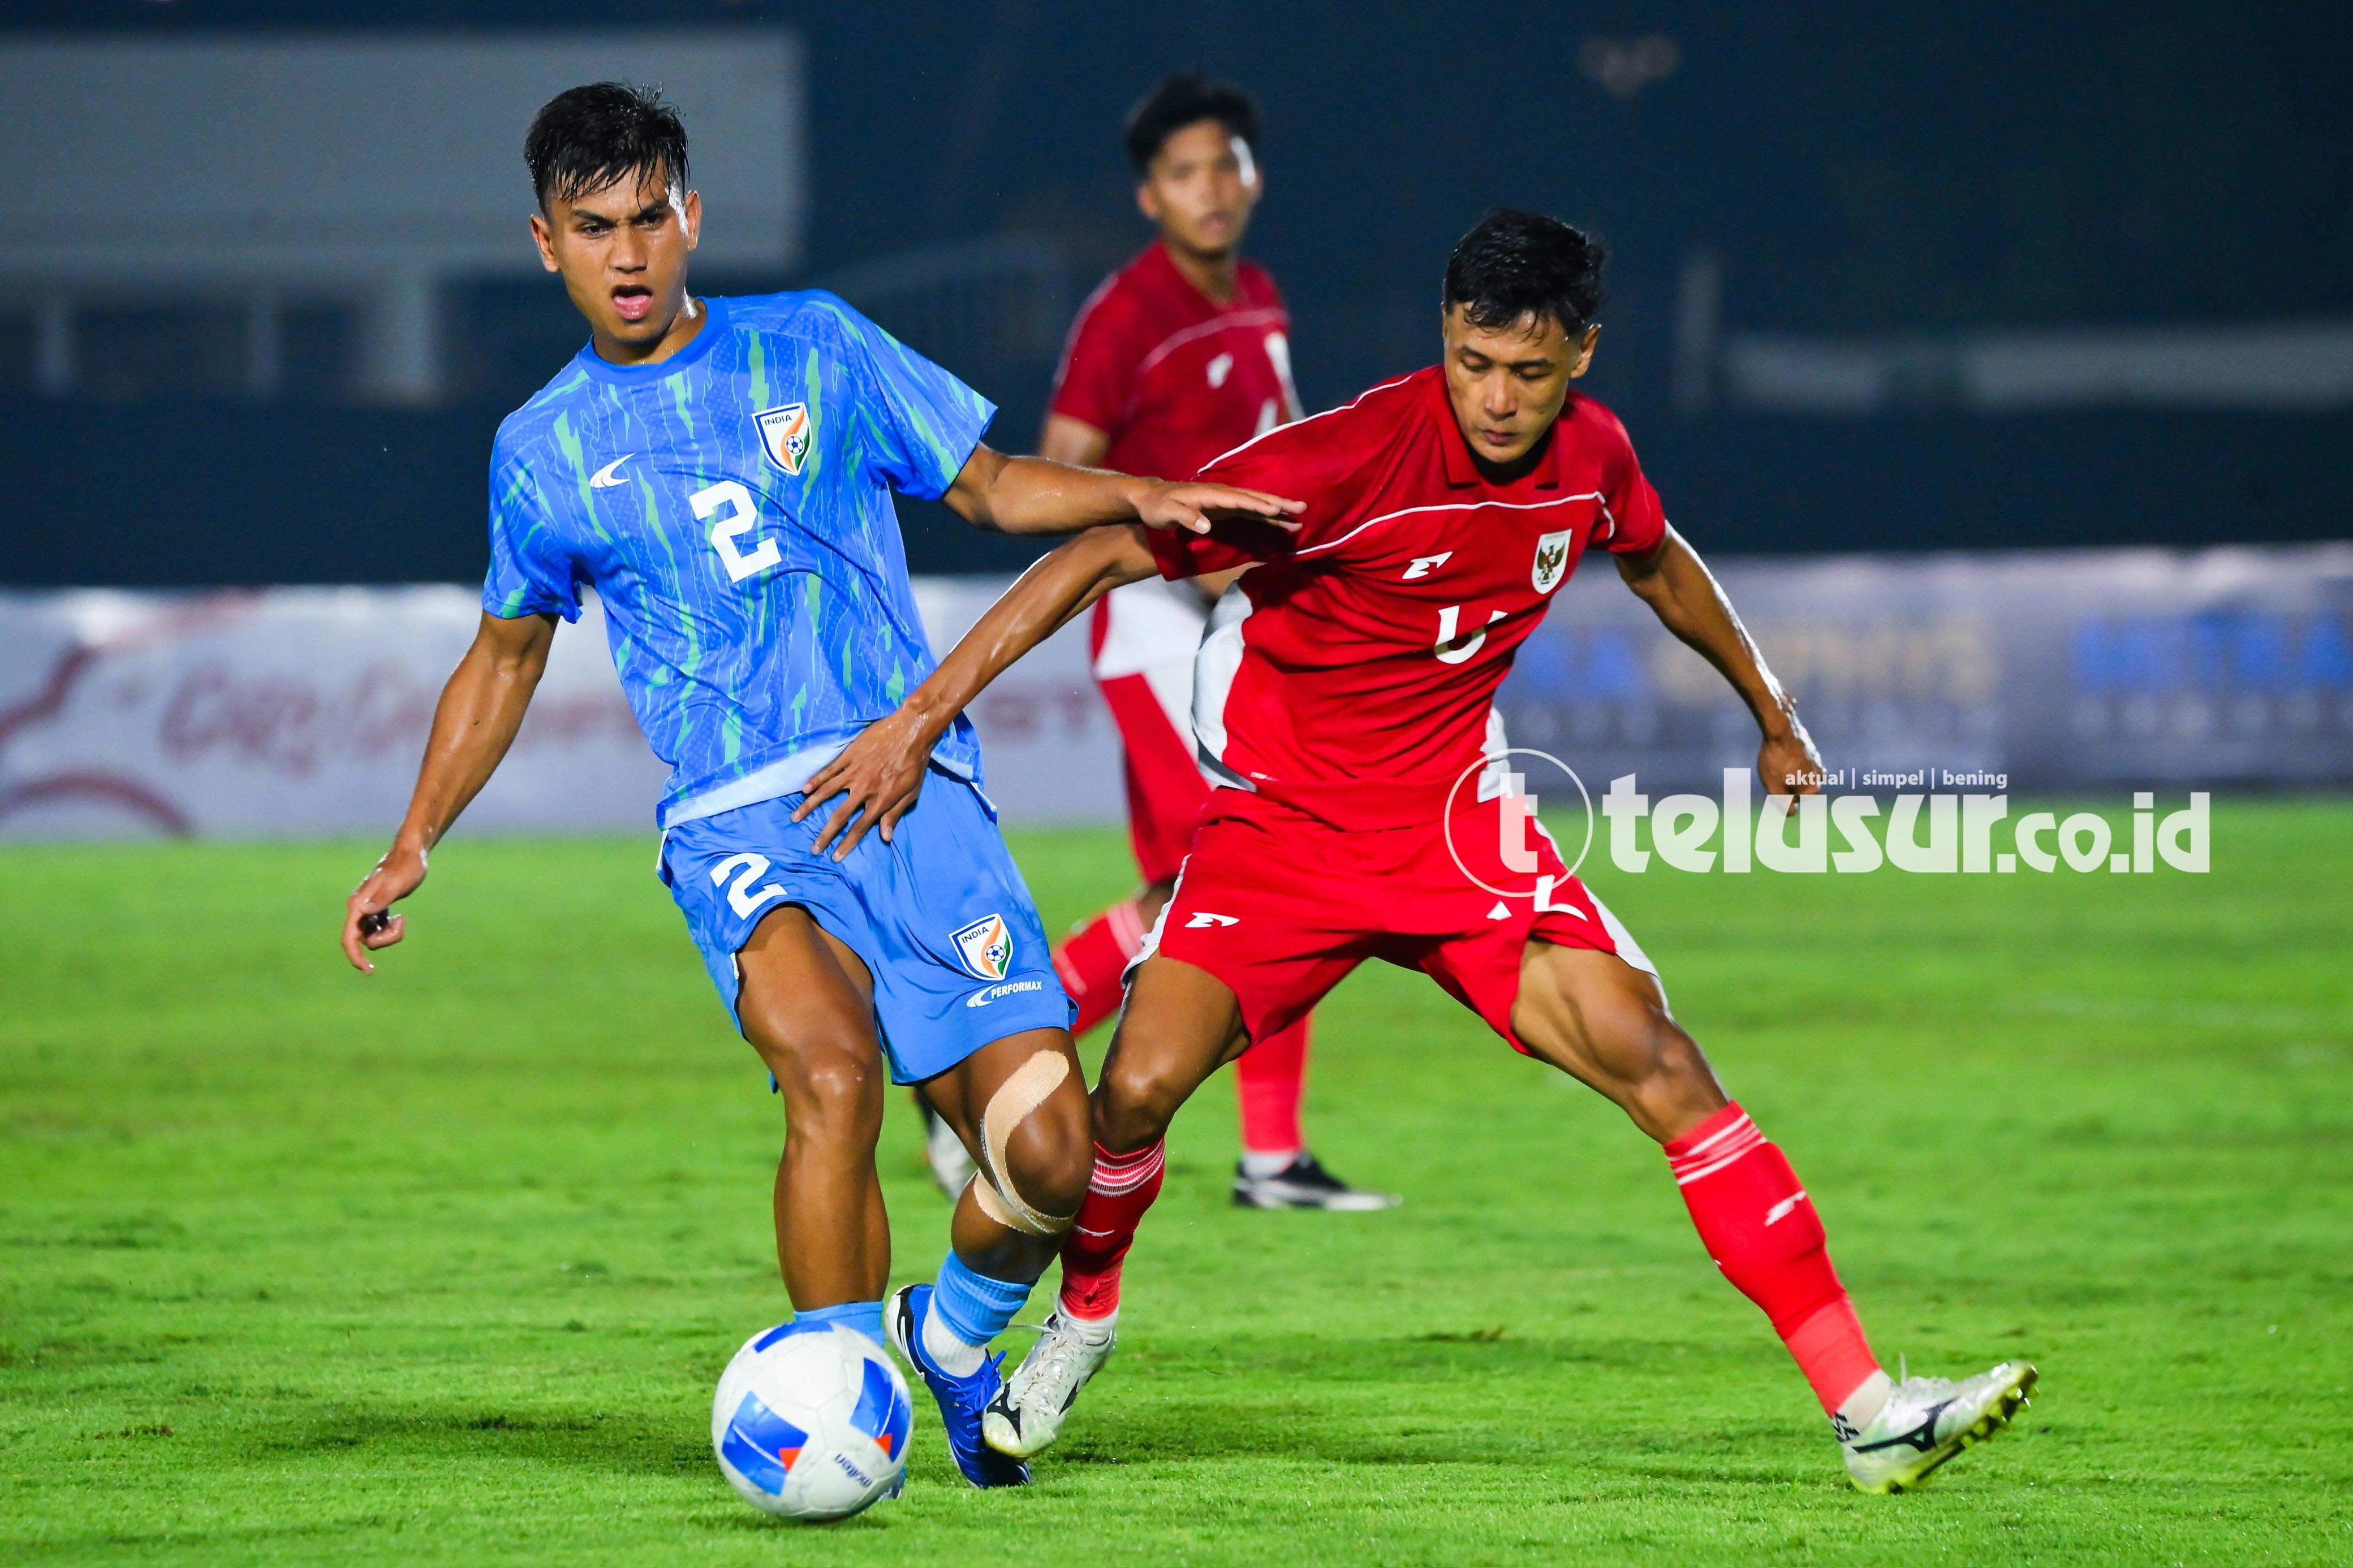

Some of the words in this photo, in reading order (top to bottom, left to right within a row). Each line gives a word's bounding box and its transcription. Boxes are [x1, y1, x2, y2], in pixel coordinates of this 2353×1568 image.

[764, 414, 792, 425] INDIA
[689, 480, 782, 583] 2
[710, 853, 788, 920] 2
[962, 927, 989, 944] INDIA
[991, 980, 1042, 999] PERFORMAX
